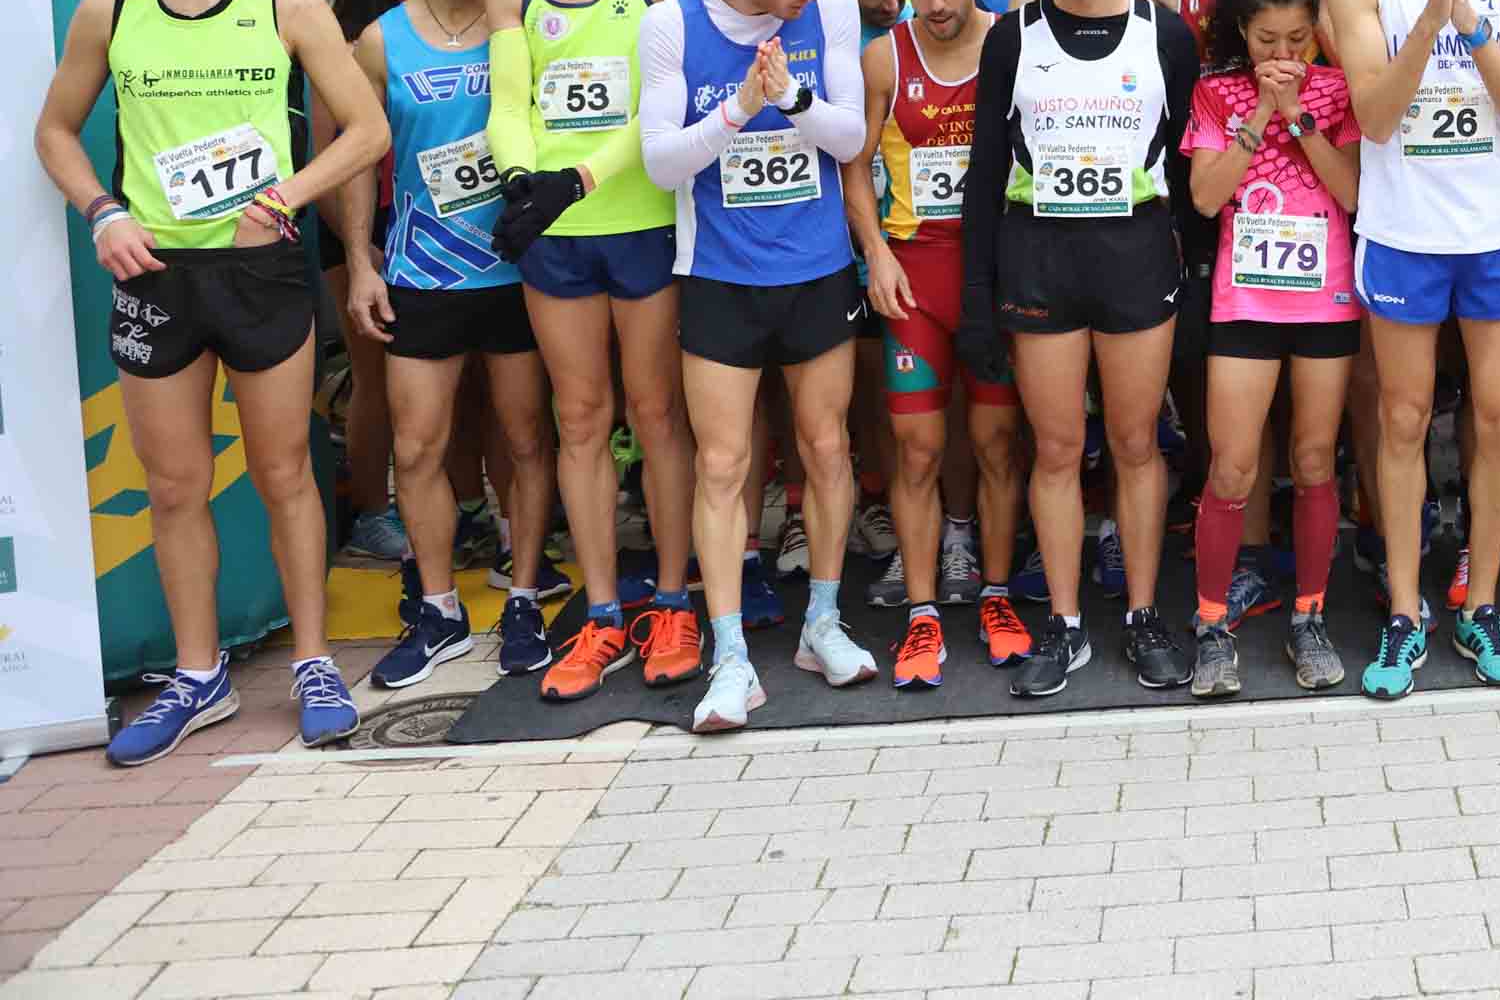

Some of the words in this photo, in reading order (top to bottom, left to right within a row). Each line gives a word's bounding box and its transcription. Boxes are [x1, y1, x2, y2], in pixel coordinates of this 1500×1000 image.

[160, 68, 234, 79] INMOBILIARIA
[235, 67, 276, 82] TEO
[566, 83, 610, 113] 53
[1033, 97, 1079, 114] JUSTO
[1084, 94, 1143, 113] MUÑOZ
[1416, 87, 1433, 95] uelta
[1065, 115, 1142, 131] SANTINOS
[1432, 108, 1478, 138] 26
[191, 147, 263, 199] 177
[455, 154, 500, 191] 95
[742, 152, 811, 187] 362
[1053, 167, 1123, 197] 365
[1255, 239, 1319, 272] 179
